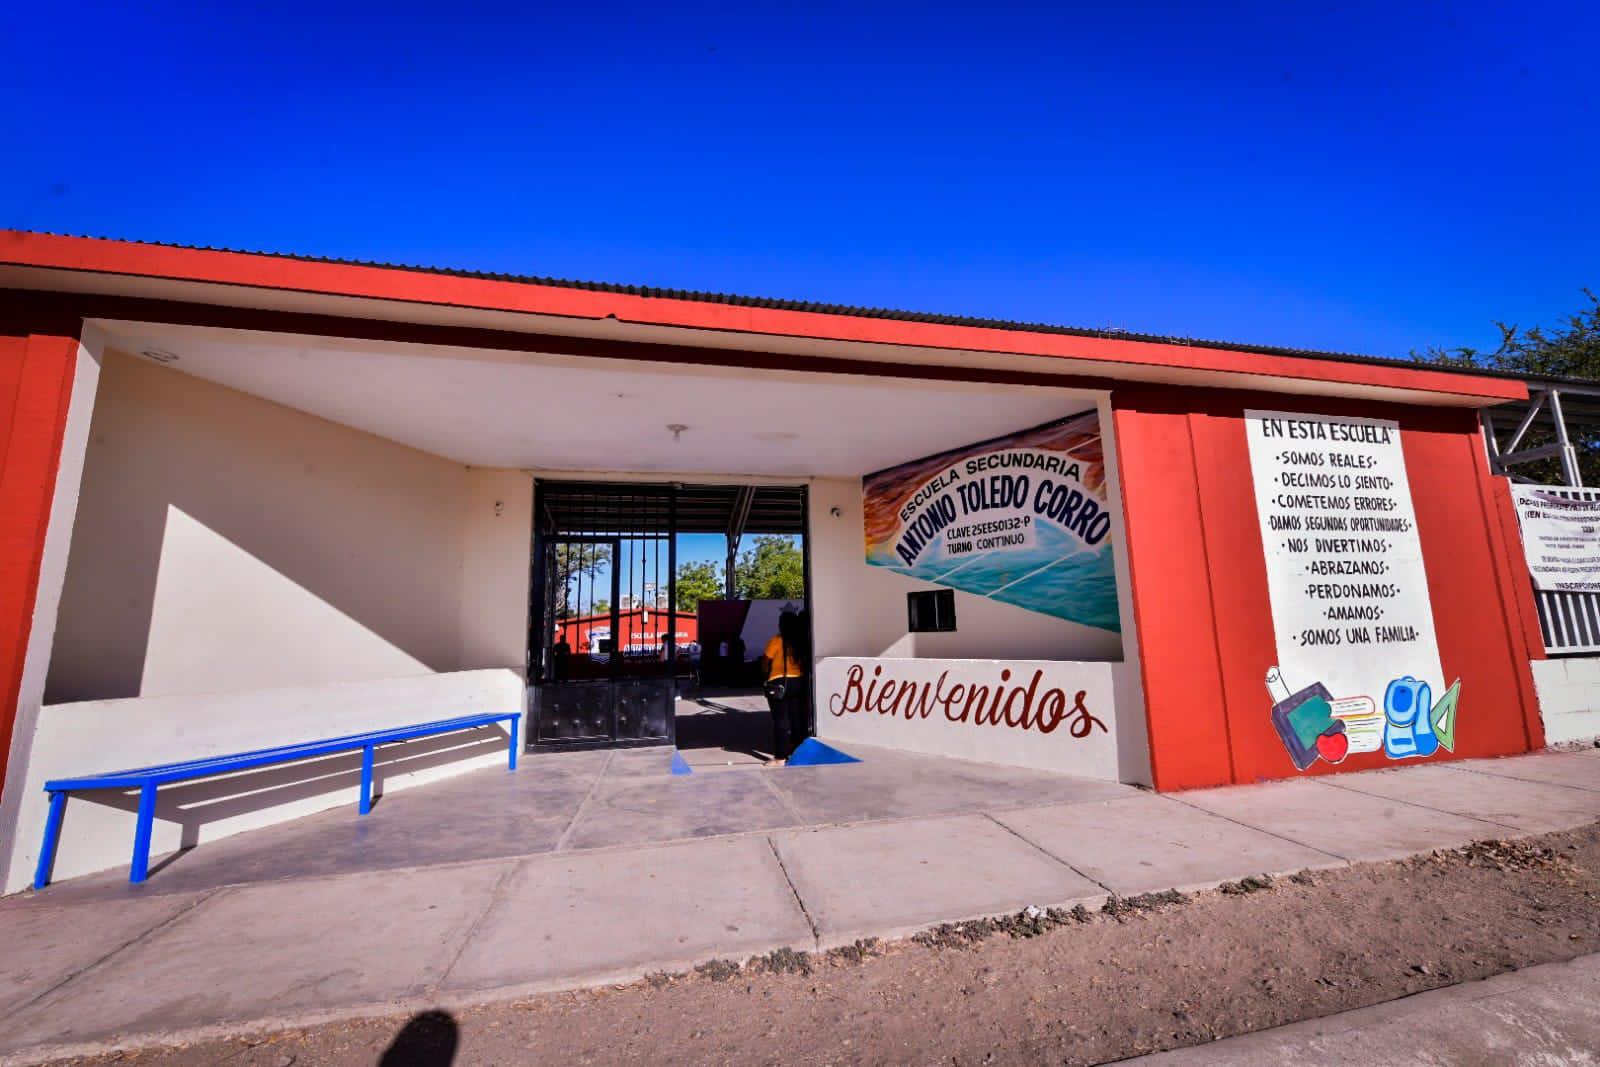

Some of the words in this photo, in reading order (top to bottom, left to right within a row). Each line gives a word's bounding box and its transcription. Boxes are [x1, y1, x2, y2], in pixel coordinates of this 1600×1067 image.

[1262, 418, 1282, 437] EN
[1288, 420, 1326, 440] ESTA
[1281, 451, 1325, 466] SOMOS
[1329, 453, 1373, 469] REALES
[900, 470, 960, 522] ESCUELA
[966, 453, 1080, 482] SECUNDARIA
[1281, 472, 1336, 488] DECIMOS
[1338, 475, 1351, 488] LO
[1355, 476, 1390, 490] SIENTO
[1277, 495, 1350, 510] COMETEMOS
[1354, 496, 1394, 511] ERRORES
[895, 494, 957, 567] ANTONIO
[956, 475, 1029, 516] TOLEDO
[1033, 479, 1111, 546] CORRO
[1270, 515, 1301, 531] DAMOS
[1305, 516, 1348, 531] SEGUNDAS
[947, 526, 971, 540] CLAVE
[947, 541, 972, 554] TURNO
[976, 533, 1025, 549] CONTINUO
[1287, 538, 1309, 553] NOS
[1315, 538, 1387, 553] DIVERTIMOS
[1311, 561, 1385, 576] ABRAZAMOS
[1308, 584, 1396, 599] PERDONAMOS
[1327, 605, 1380, 621] AMAMOS
[1300, 628, 1341, 647] SOMOS
[1346, 627, 1371, 645] UNA
[1375, 626, 1416, 643] FAMILIA
[829, 664, 1109, 738] Bienvenidos
